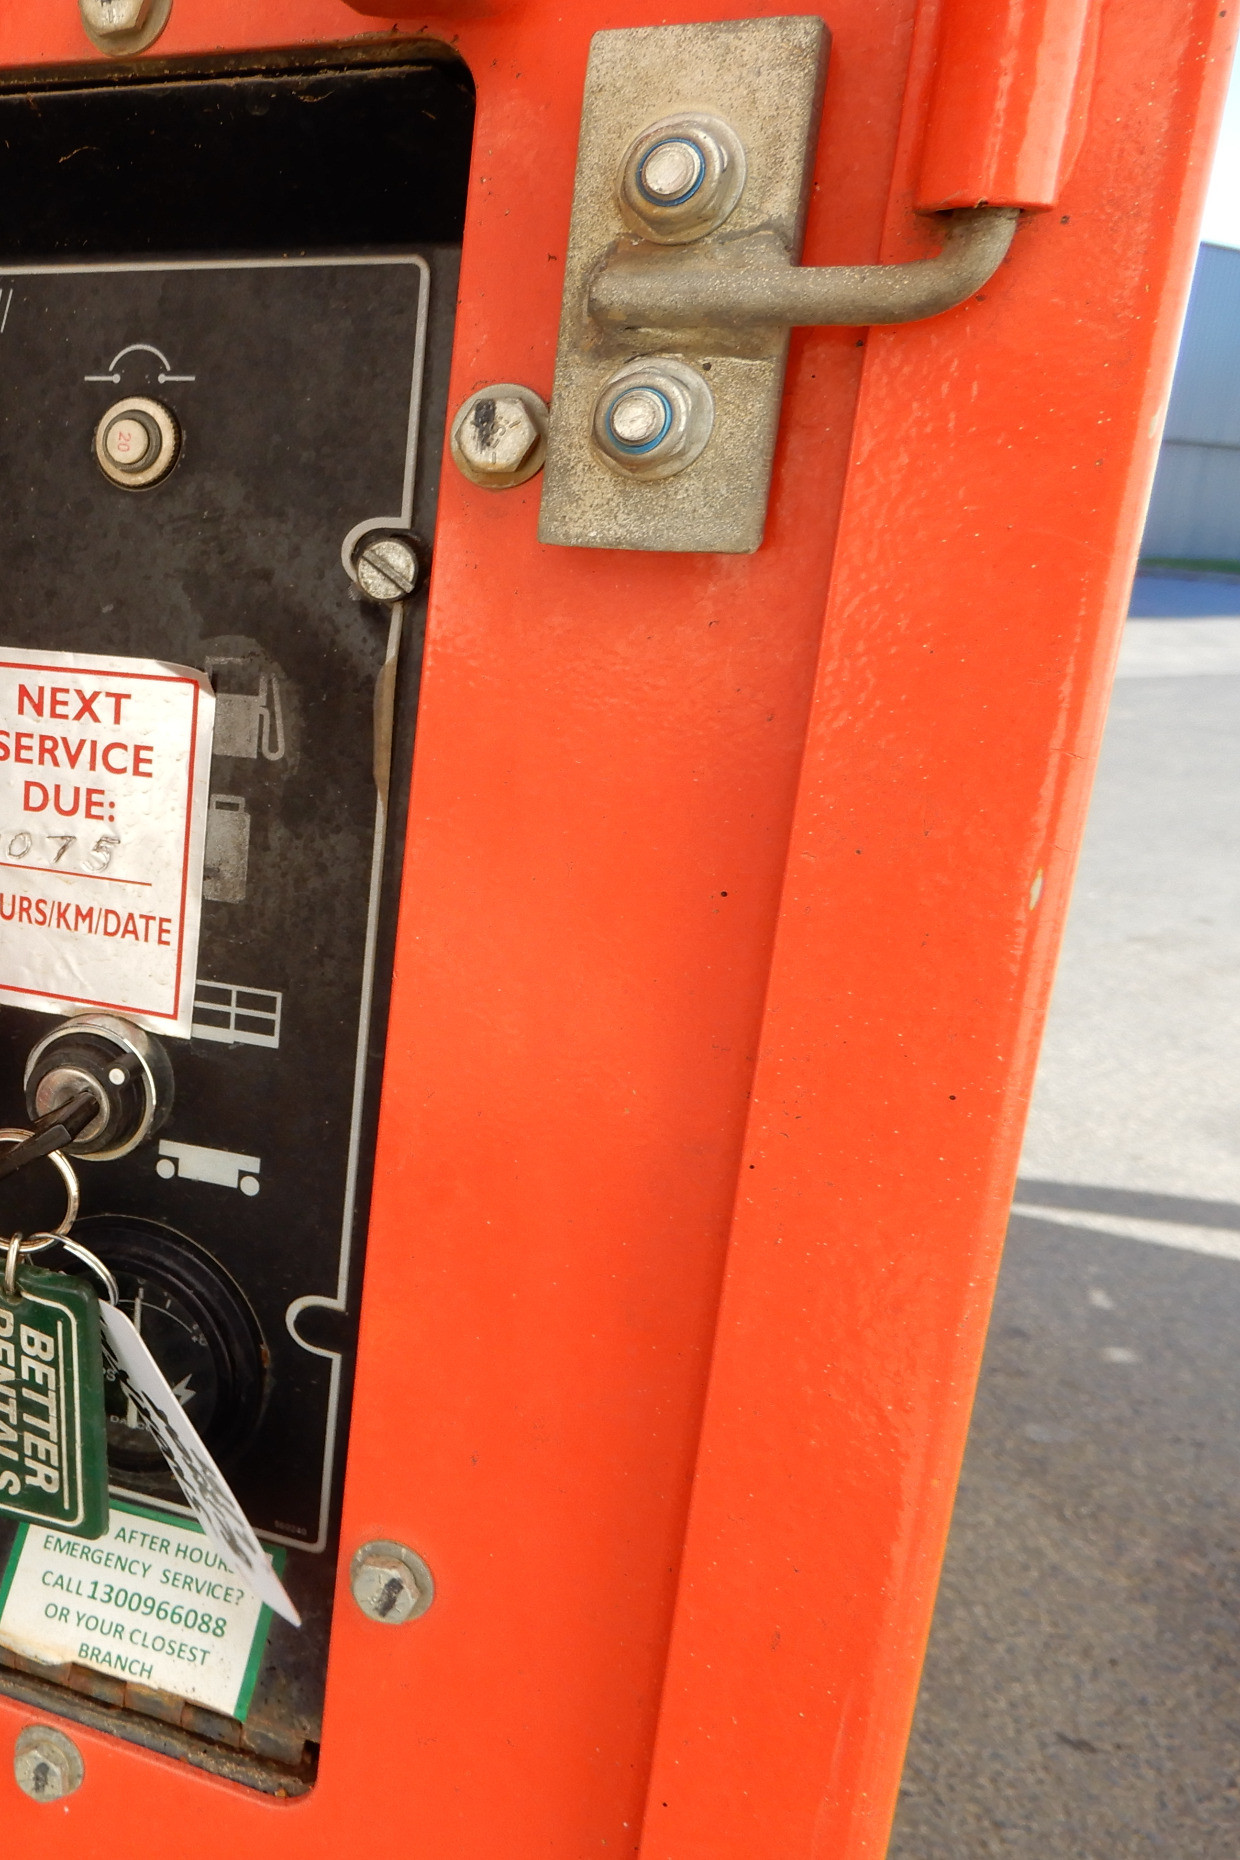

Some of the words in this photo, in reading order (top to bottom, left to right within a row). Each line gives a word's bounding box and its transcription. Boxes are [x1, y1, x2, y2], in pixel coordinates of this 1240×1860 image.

[117, 431, 132, 452] 20
[17, 683, 131, 725] NEXT
[23, 780, 116, 822] DUE:
[19, 1323, 60, 1494] BETTER
[43, 1535, 152, 1578] EMERGENCY
[160, 1569, 245, 1606] SERVICE?
[114, 1526, 171, 1554] AFTER
[175, 1543, 235, 1574] HOUR
[41, 1570, 83, 1596] CALL
[87, 1580, 227, 1638] 1300966088
[44, 1603, 70, 1624] OR
[75, 1611, 125, 1641] YOUR
[129, 1628, 211, 1666] CLOSEST
[77, 1642, 154, 1680] BRANCH
